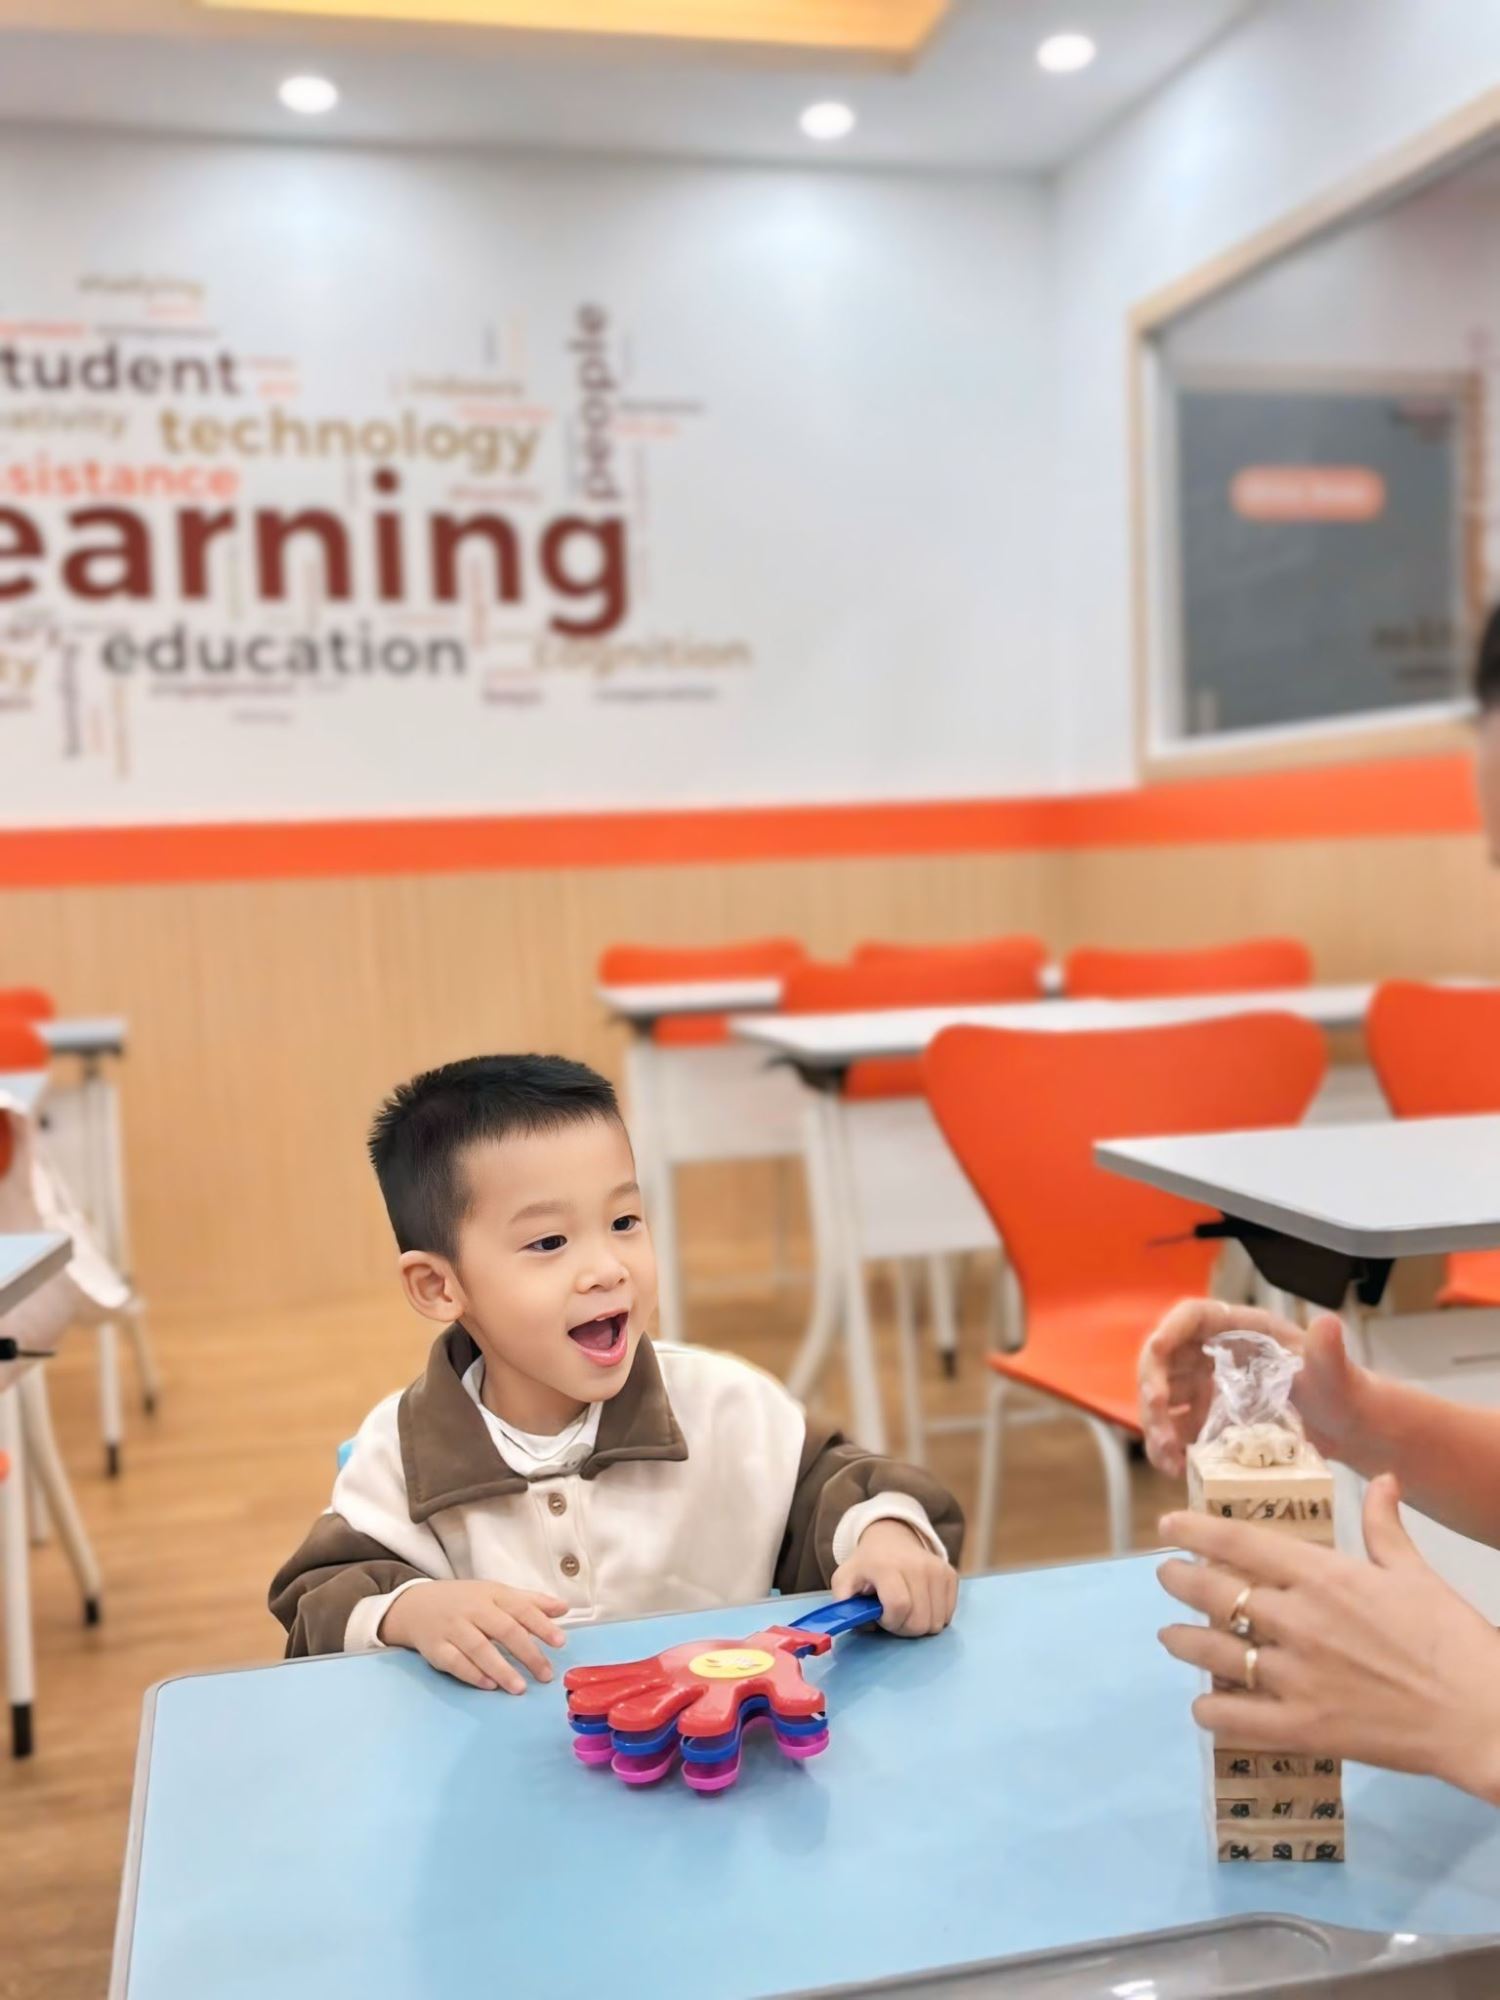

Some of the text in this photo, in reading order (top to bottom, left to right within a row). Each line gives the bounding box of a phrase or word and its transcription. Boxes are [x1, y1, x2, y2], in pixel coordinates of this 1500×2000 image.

[566, 302, 618, 500] people
[159, 405, 541, 475] technology
[0, 452, 239, 498] sistance
[102, 618, 465, 679] education
